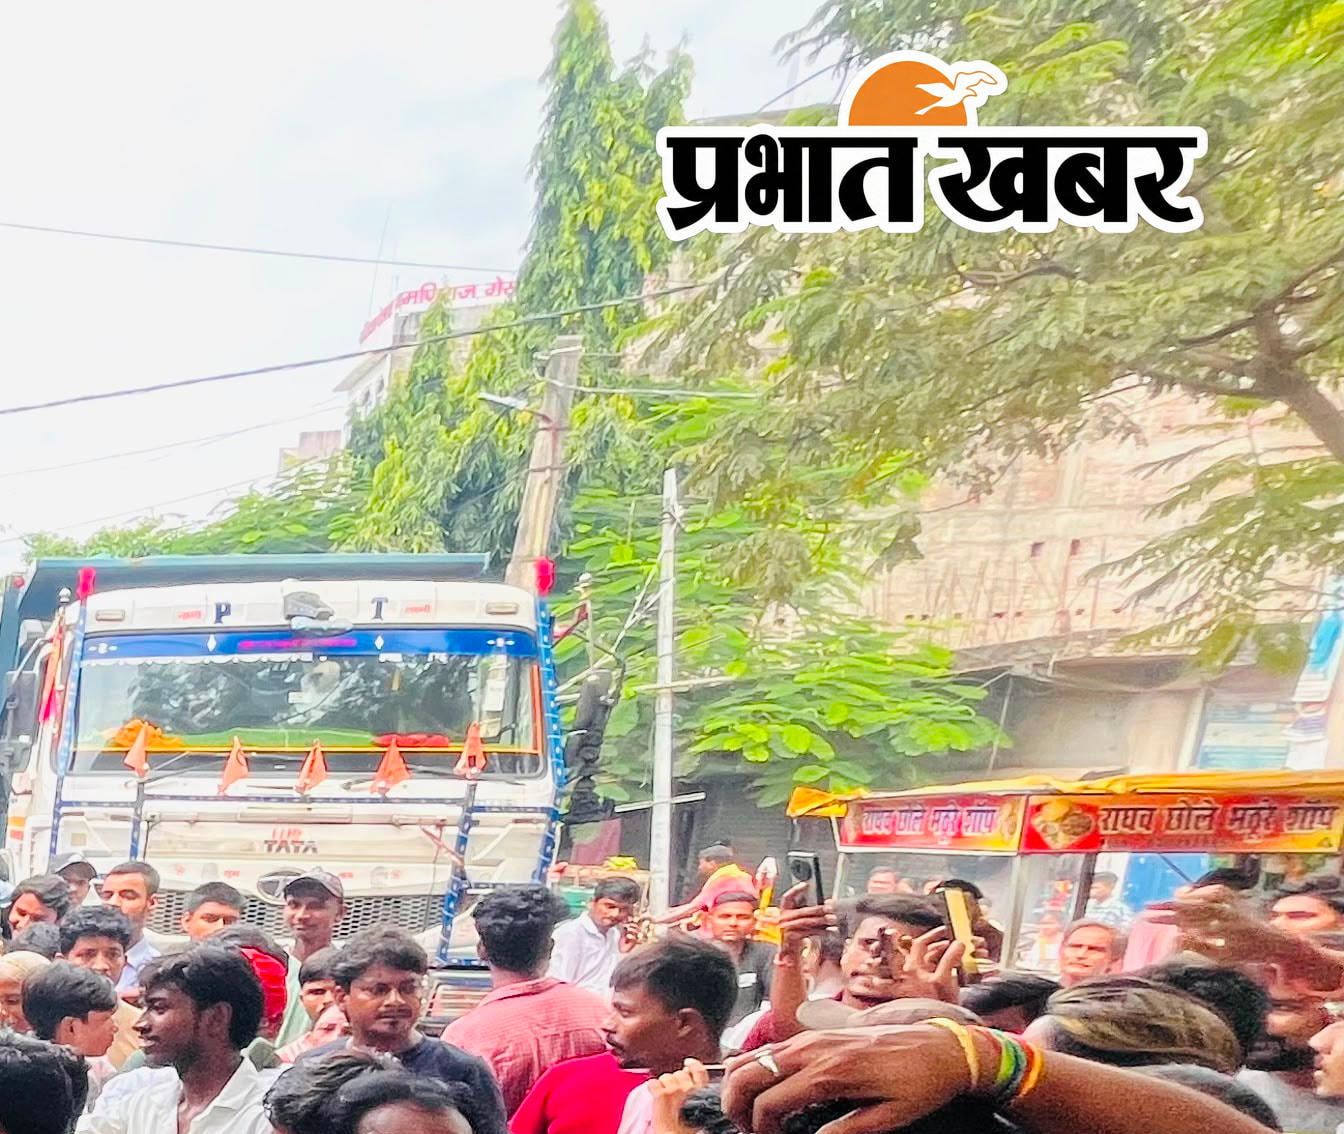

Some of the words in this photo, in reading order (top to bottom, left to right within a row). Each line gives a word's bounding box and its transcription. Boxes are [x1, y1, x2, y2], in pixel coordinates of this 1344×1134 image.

[214, 601, 232, 625] P
[370, 596, 389, 621] T
[1098, 805, 1159, 834] राघव
[1164, 797, 1221, 834] छोले
[1281, 799, 1339, 833] शॉप
[263, 840, 318, 854] TATA
